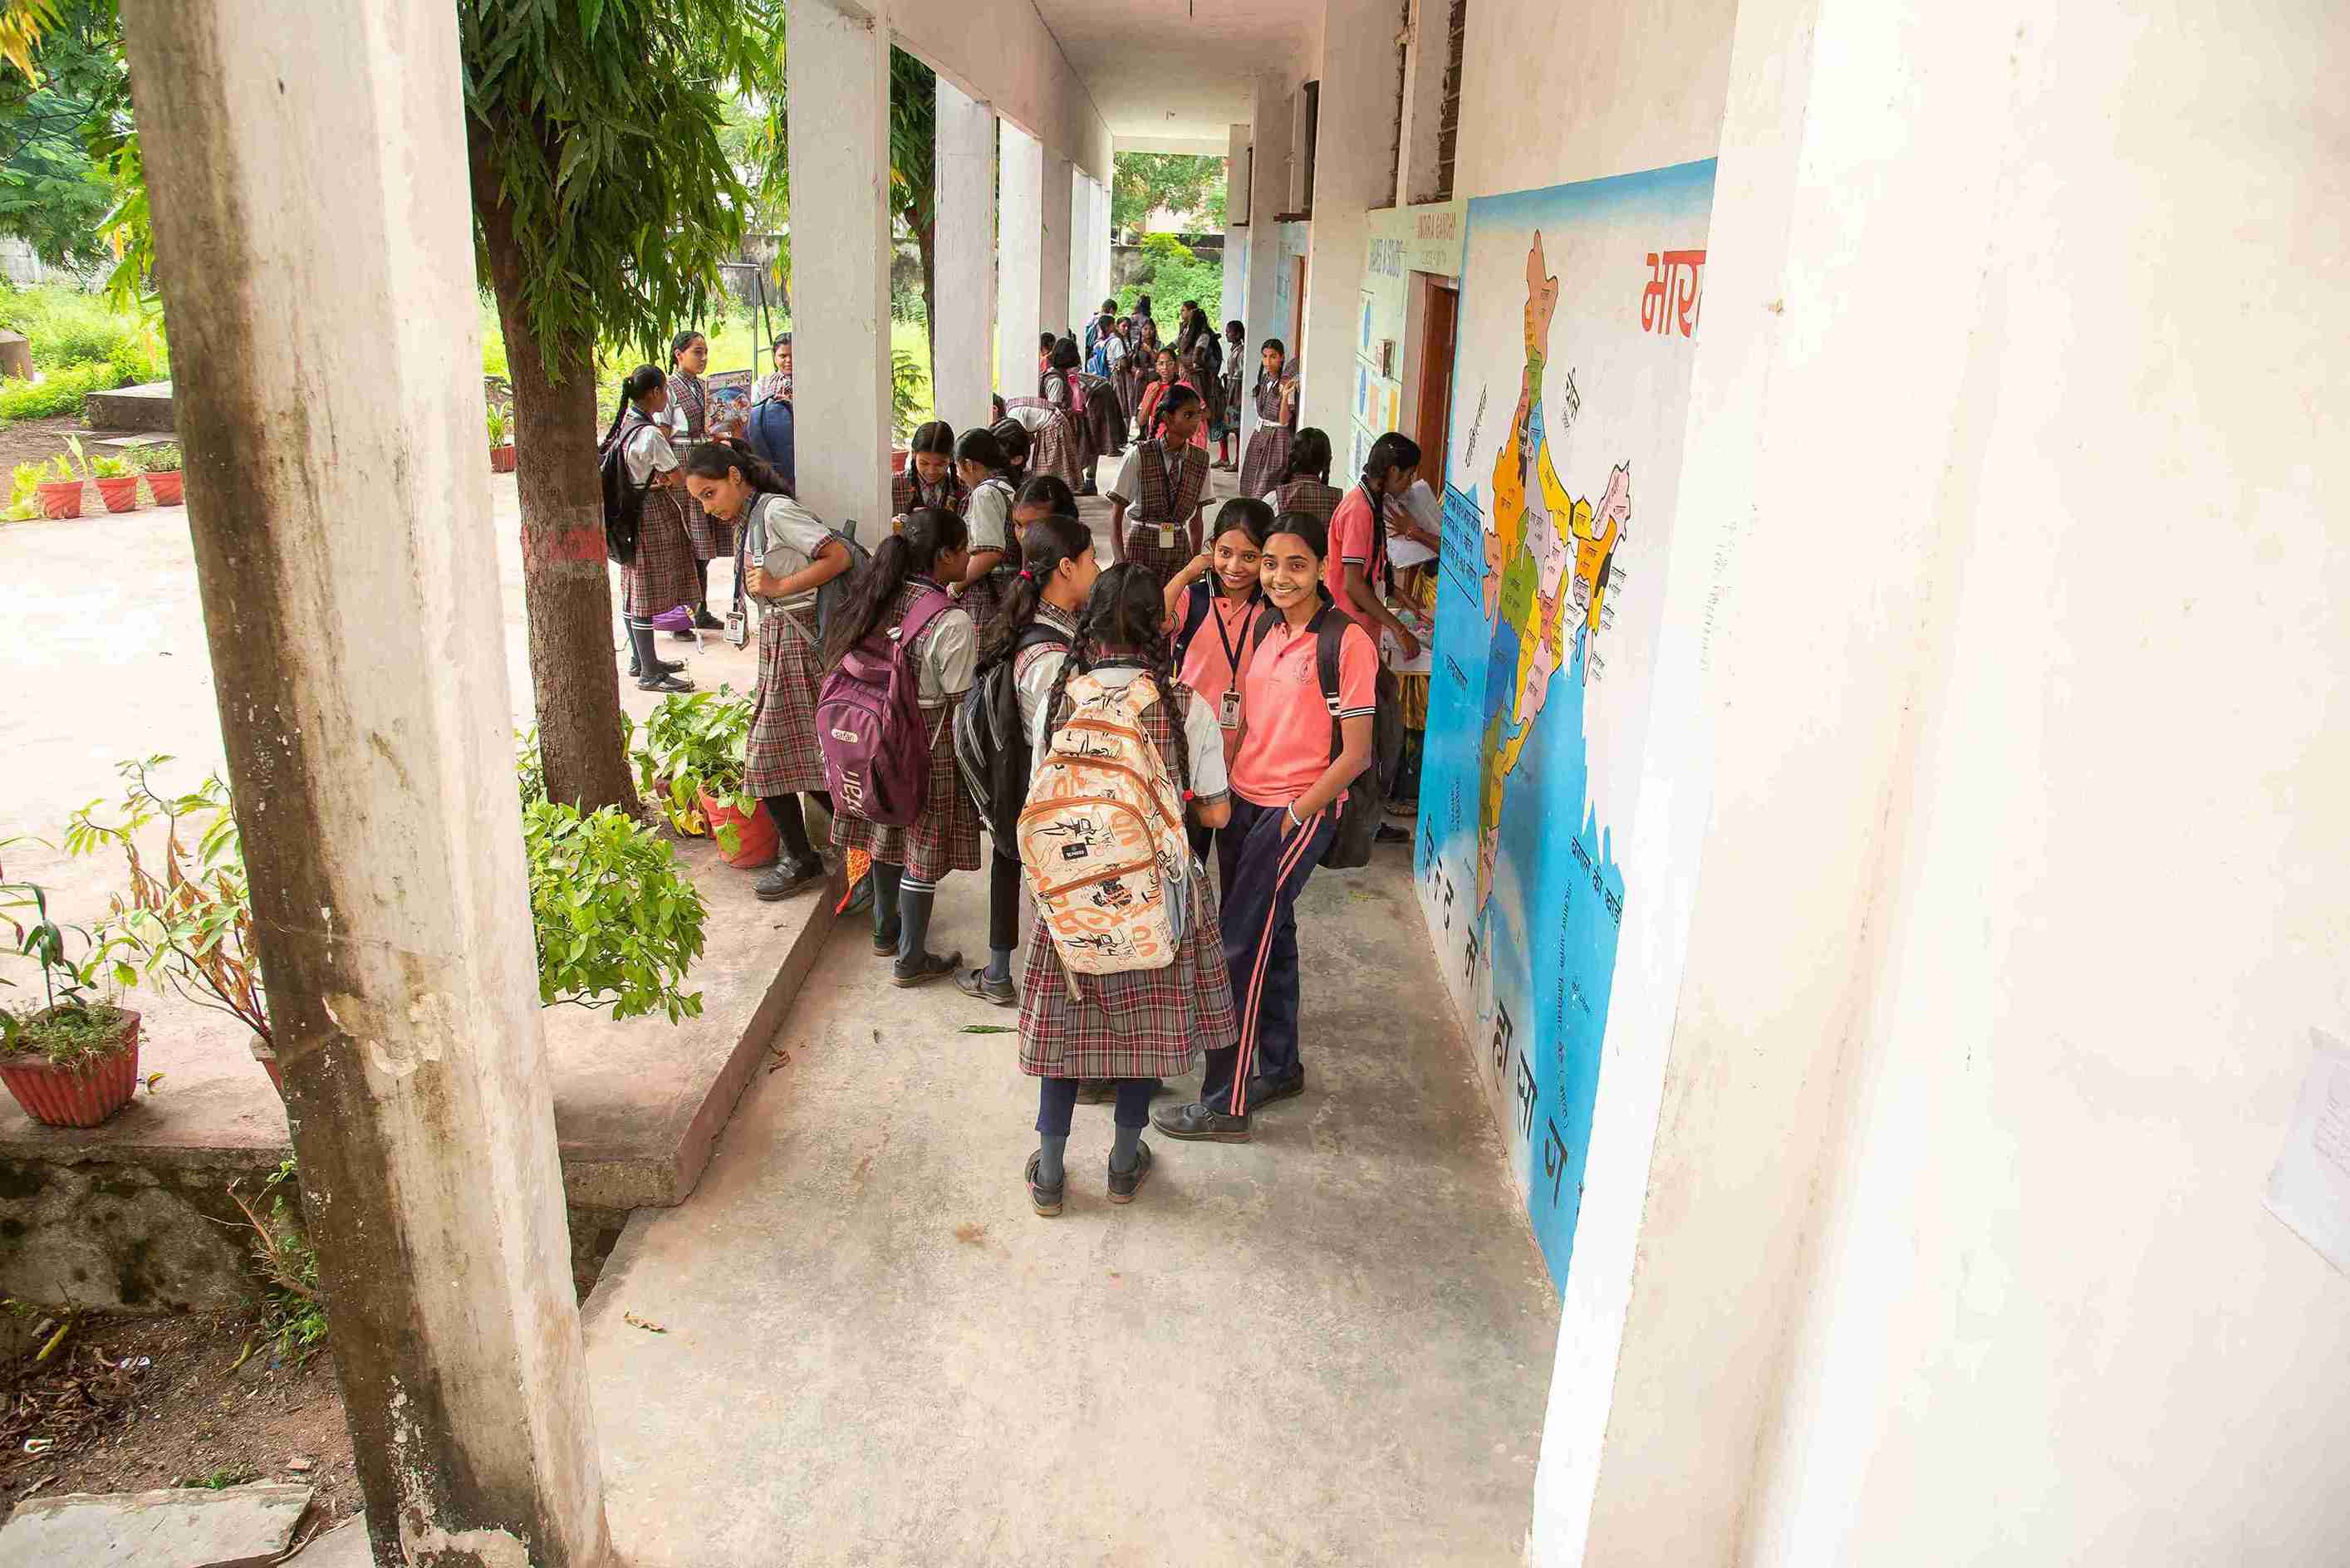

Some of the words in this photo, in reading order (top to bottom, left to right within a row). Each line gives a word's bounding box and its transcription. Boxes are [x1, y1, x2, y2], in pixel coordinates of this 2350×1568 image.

[1641, 250, 1707, 338] भार
[1566, 366, 1580, 422] चीन
[1592, 865, 1603, 898] की
